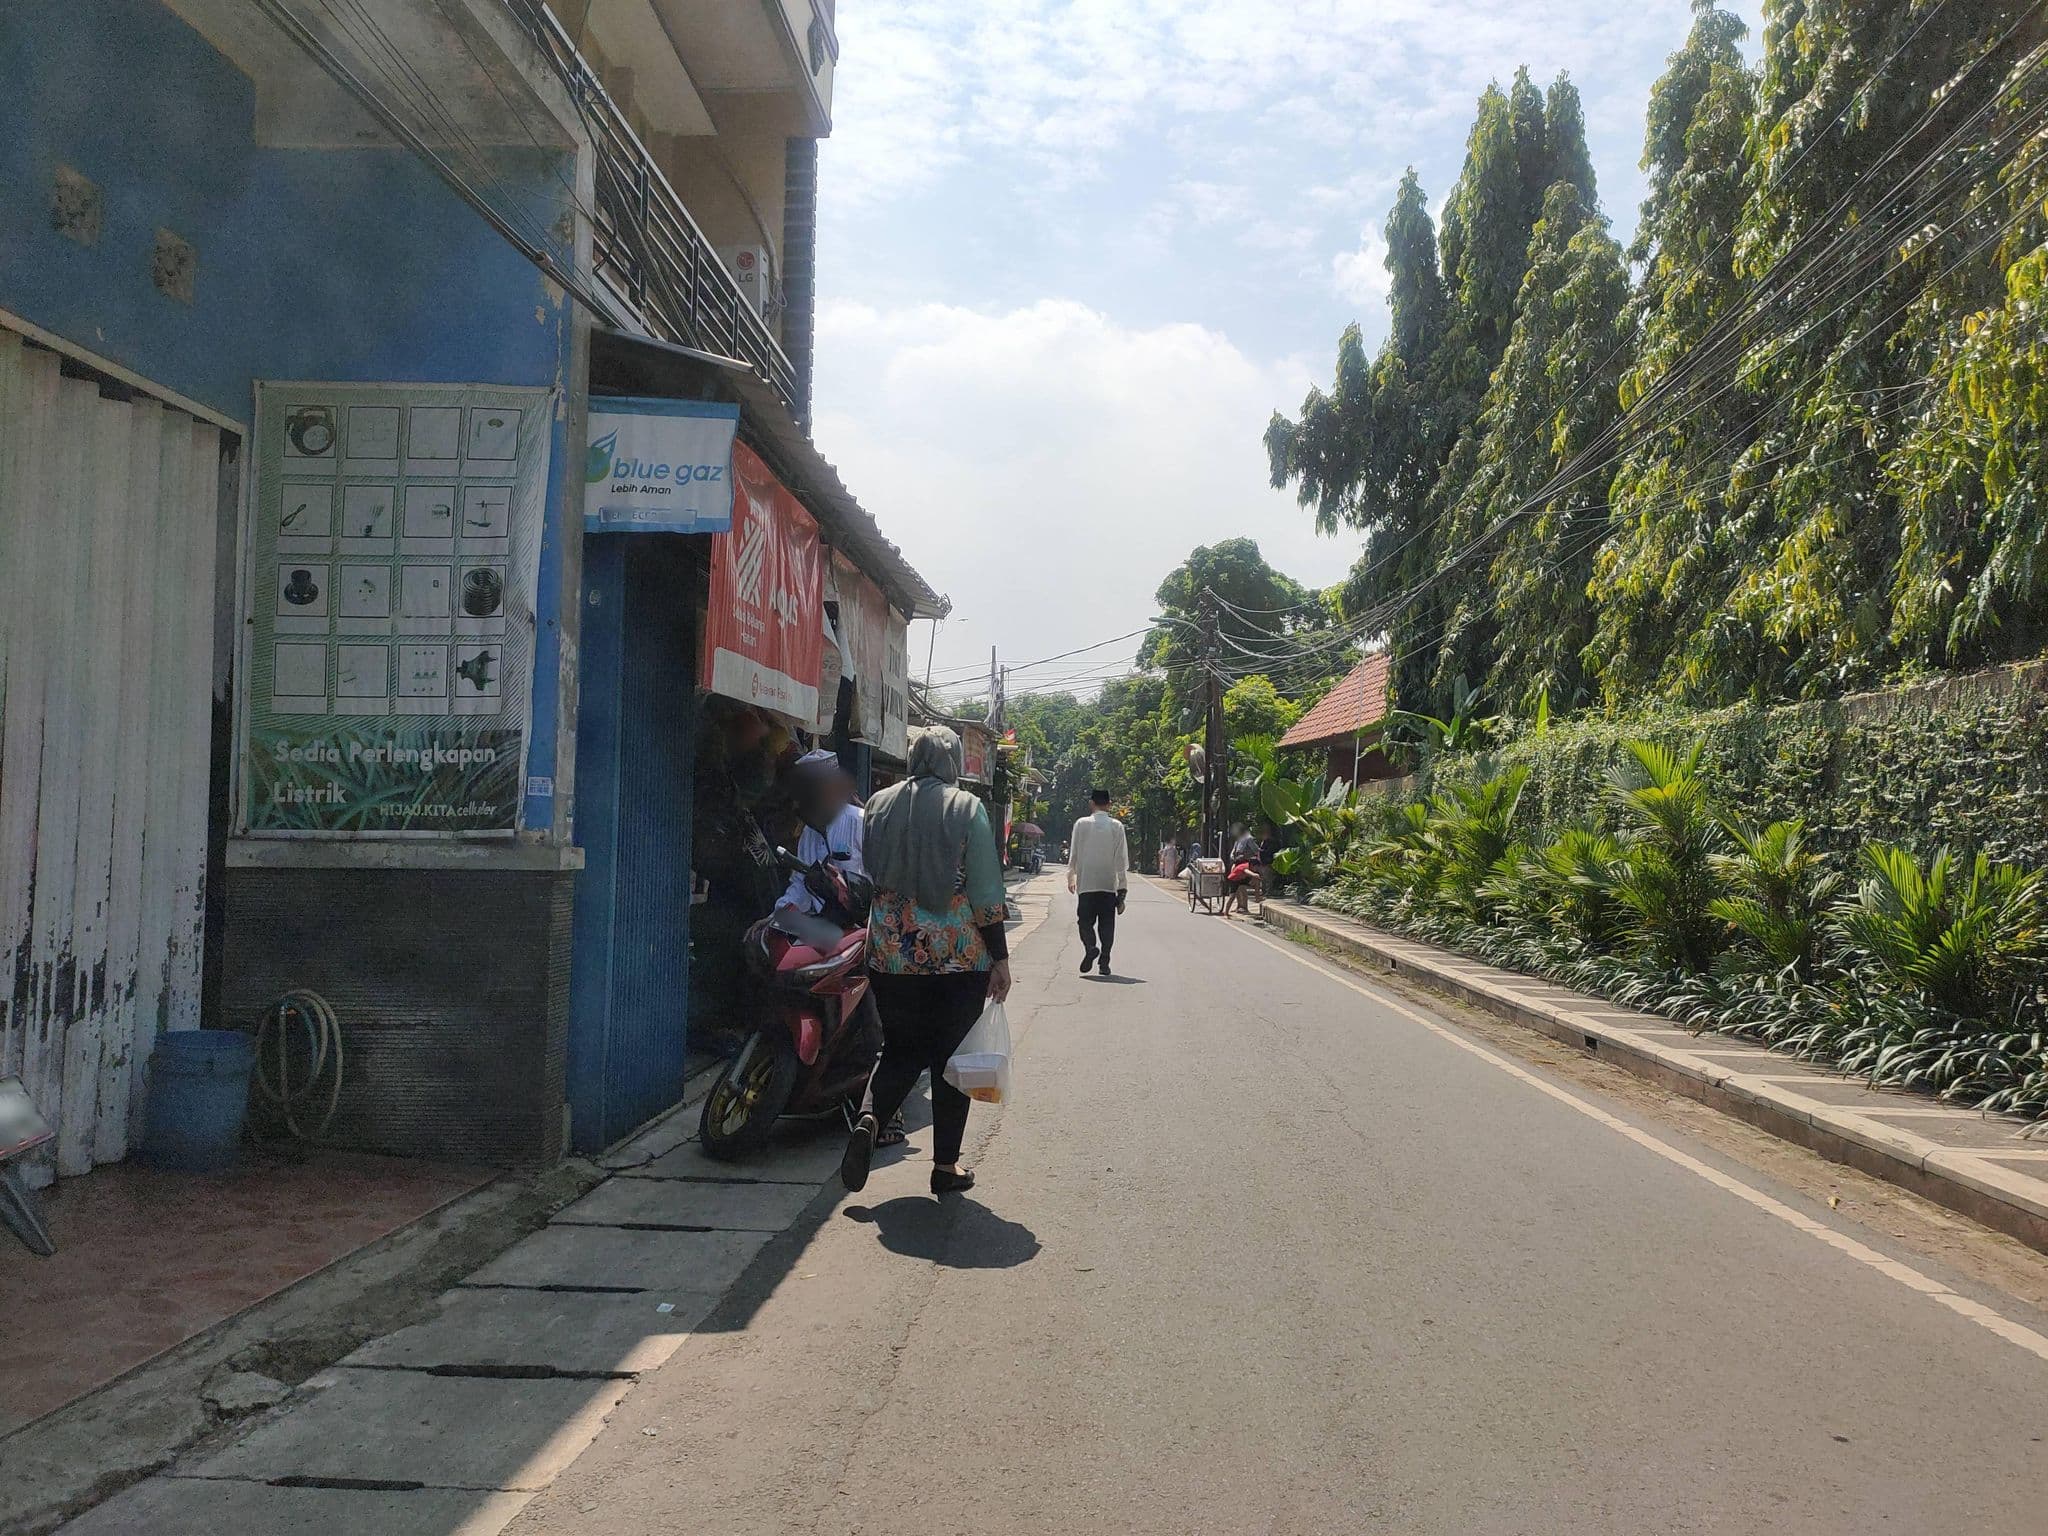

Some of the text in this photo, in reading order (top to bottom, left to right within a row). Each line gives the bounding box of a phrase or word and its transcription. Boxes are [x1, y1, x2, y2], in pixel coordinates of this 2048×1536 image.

[738, 272, 753, 282] LG
[613, 457, 723, 485] blue gaz
[611, 484, 671, 495] Lebih Aman
[275, 740, 496, 771] Sedia Perlengkapan
[273, 781, 346, 804] Listrik
